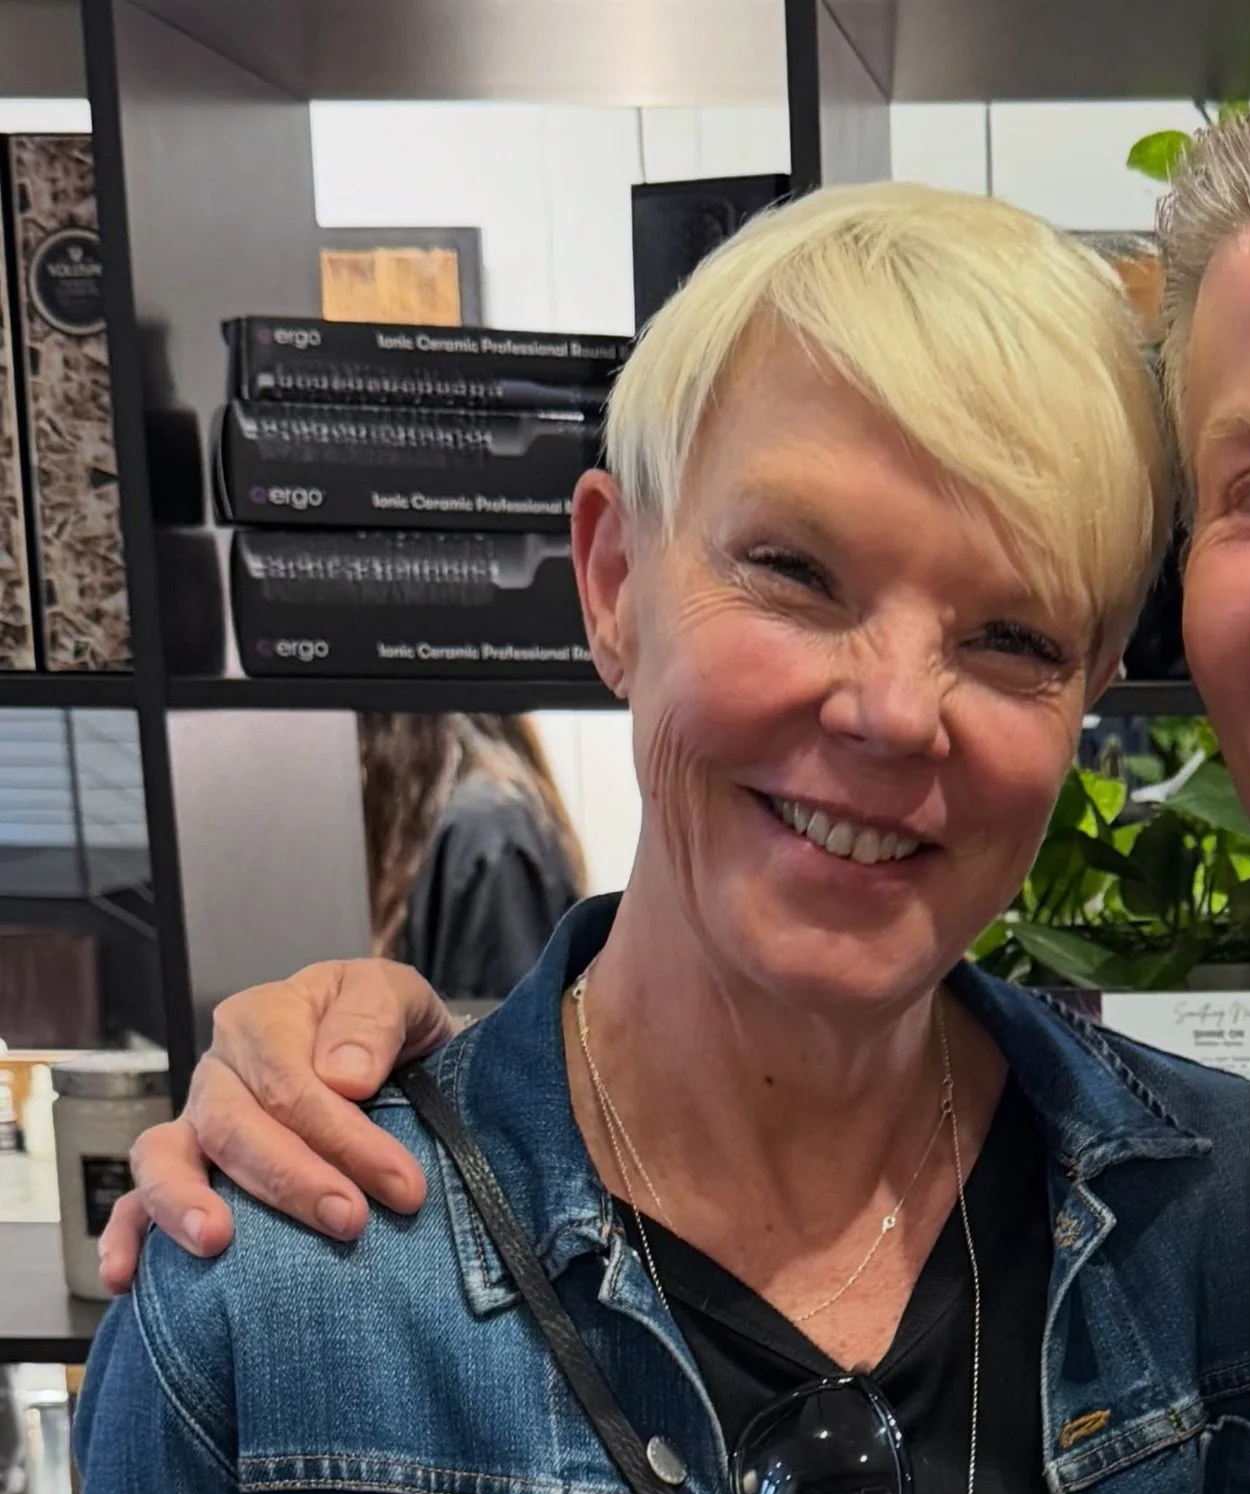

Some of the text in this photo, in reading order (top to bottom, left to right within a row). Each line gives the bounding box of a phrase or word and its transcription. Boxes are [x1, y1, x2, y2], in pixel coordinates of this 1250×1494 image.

[273, 329, 321, 349] ergo
[375, 332, 616, 360] Ionic Ceramic Professional Round
[268, 487, 322, 510] ergo
[371, 491, 409, 509] Ionic
[411, 492, 473, 511] Ceramic
[475, 494, 562, 515] Professional
[275, 639, 329, 662] ergo
[376, 640, 415, 659] Ionic
[417, 642, 479, 660] Ceramic
[481, 643, 569, 661] Professional
